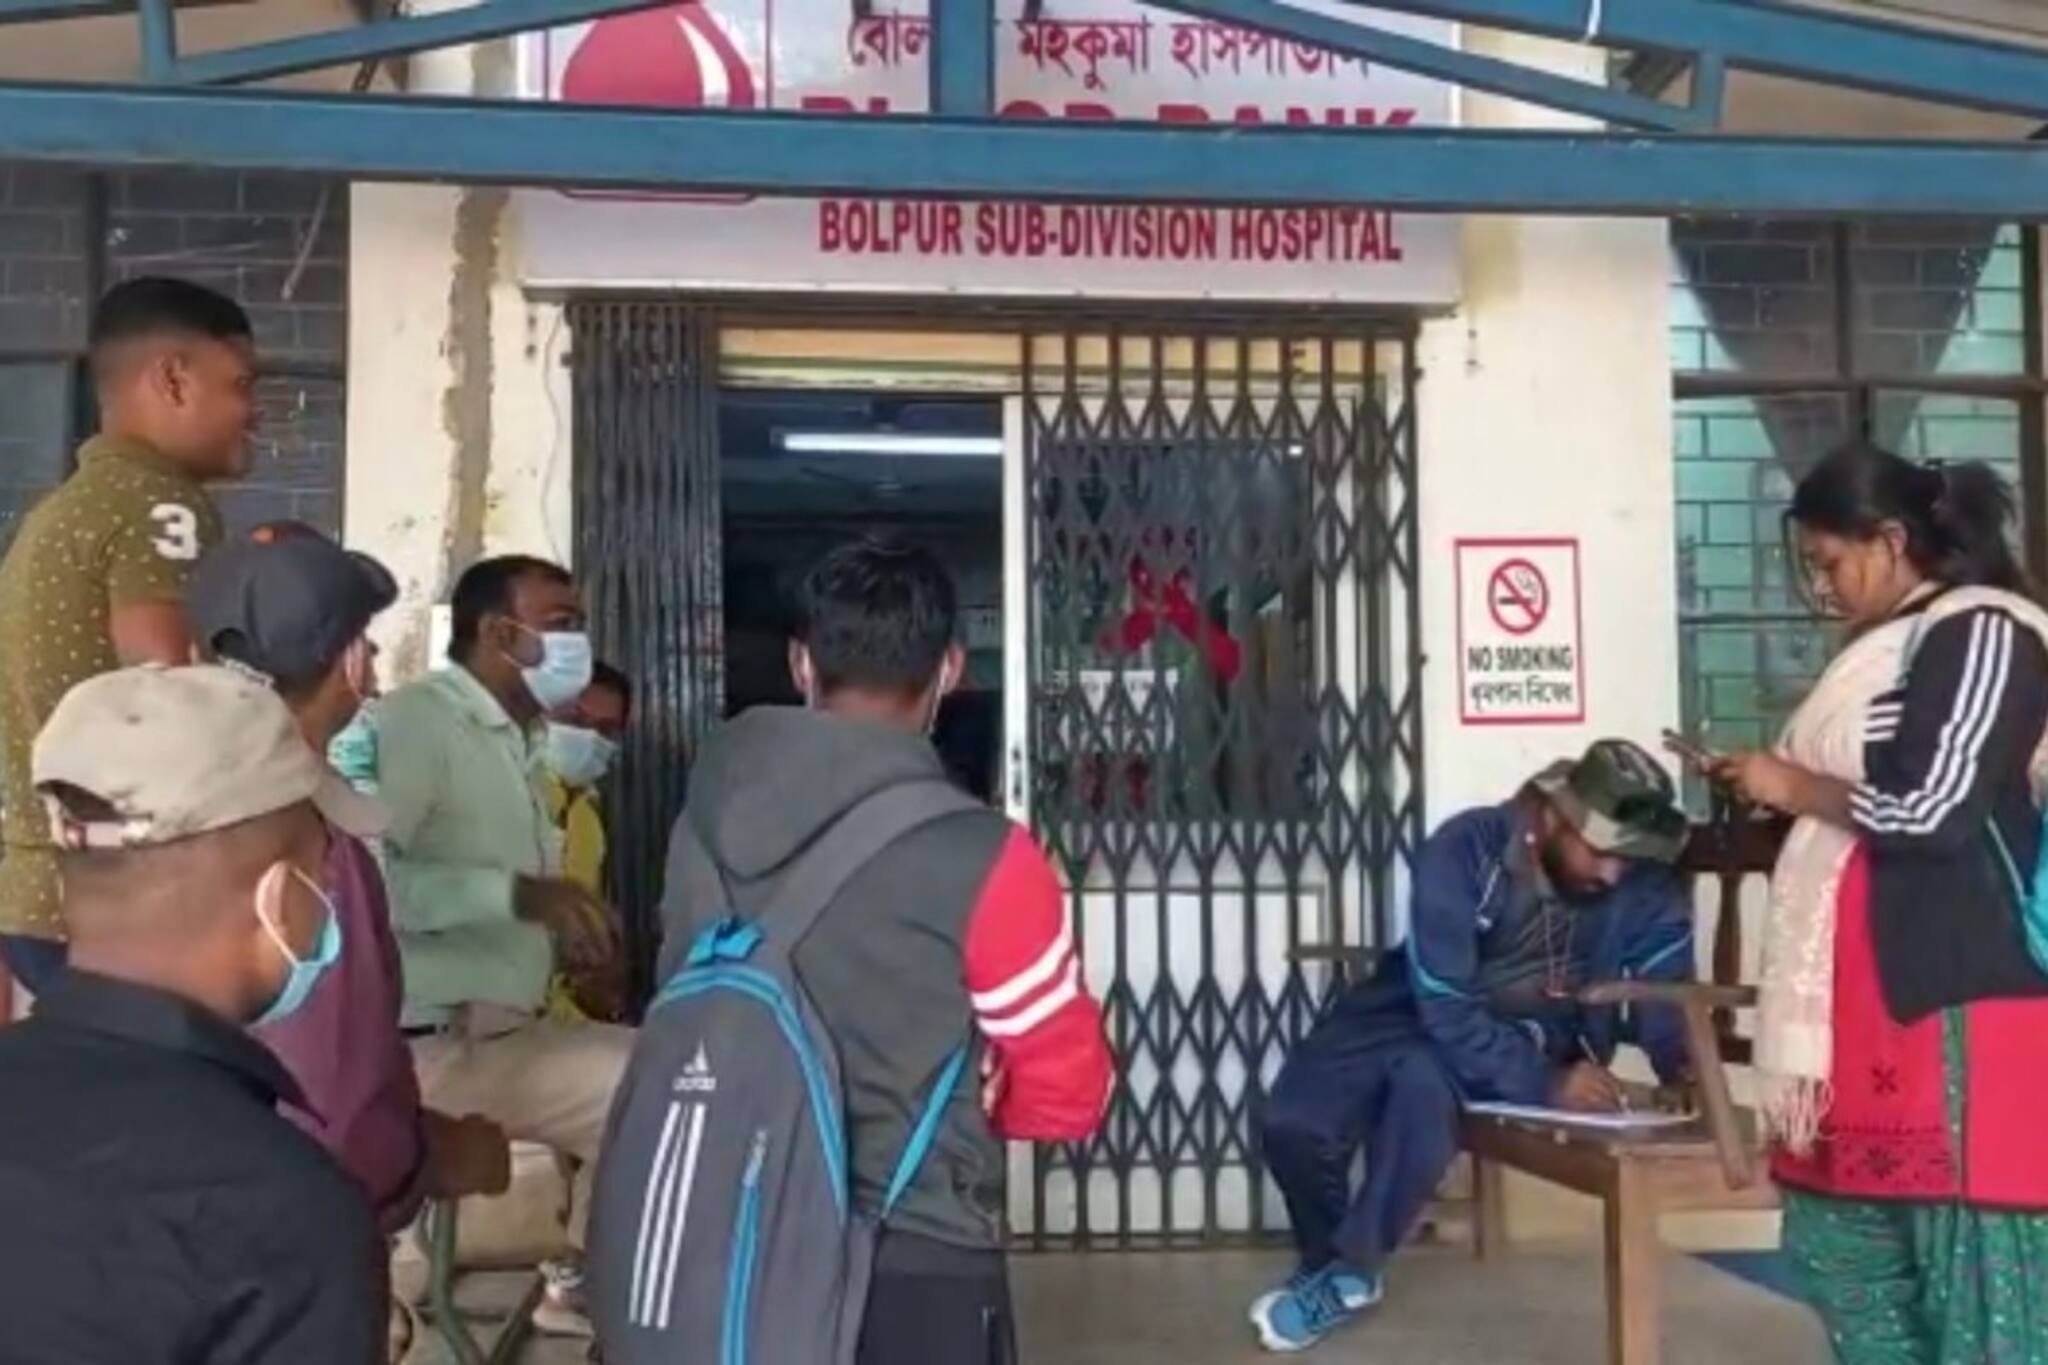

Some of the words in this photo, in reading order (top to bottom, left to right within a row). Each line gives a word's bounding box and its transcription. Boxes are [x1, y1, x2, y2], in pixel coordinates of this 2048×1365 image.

[1015, 15, 1153, 90] মহকুমা
[1168, 22, 1369, 79] হাসপাতা
[819, 201, 963, 254] BOLPUR
[976, 205, 1217, 260] SUB-DIVISION
[1230, 208, 1403, 262] HOSPITAL
[150, 502, 198, 560] 3
[1468, 646, 1491, 671] NO
[1496, 646, 1573, 671] SMOKING
